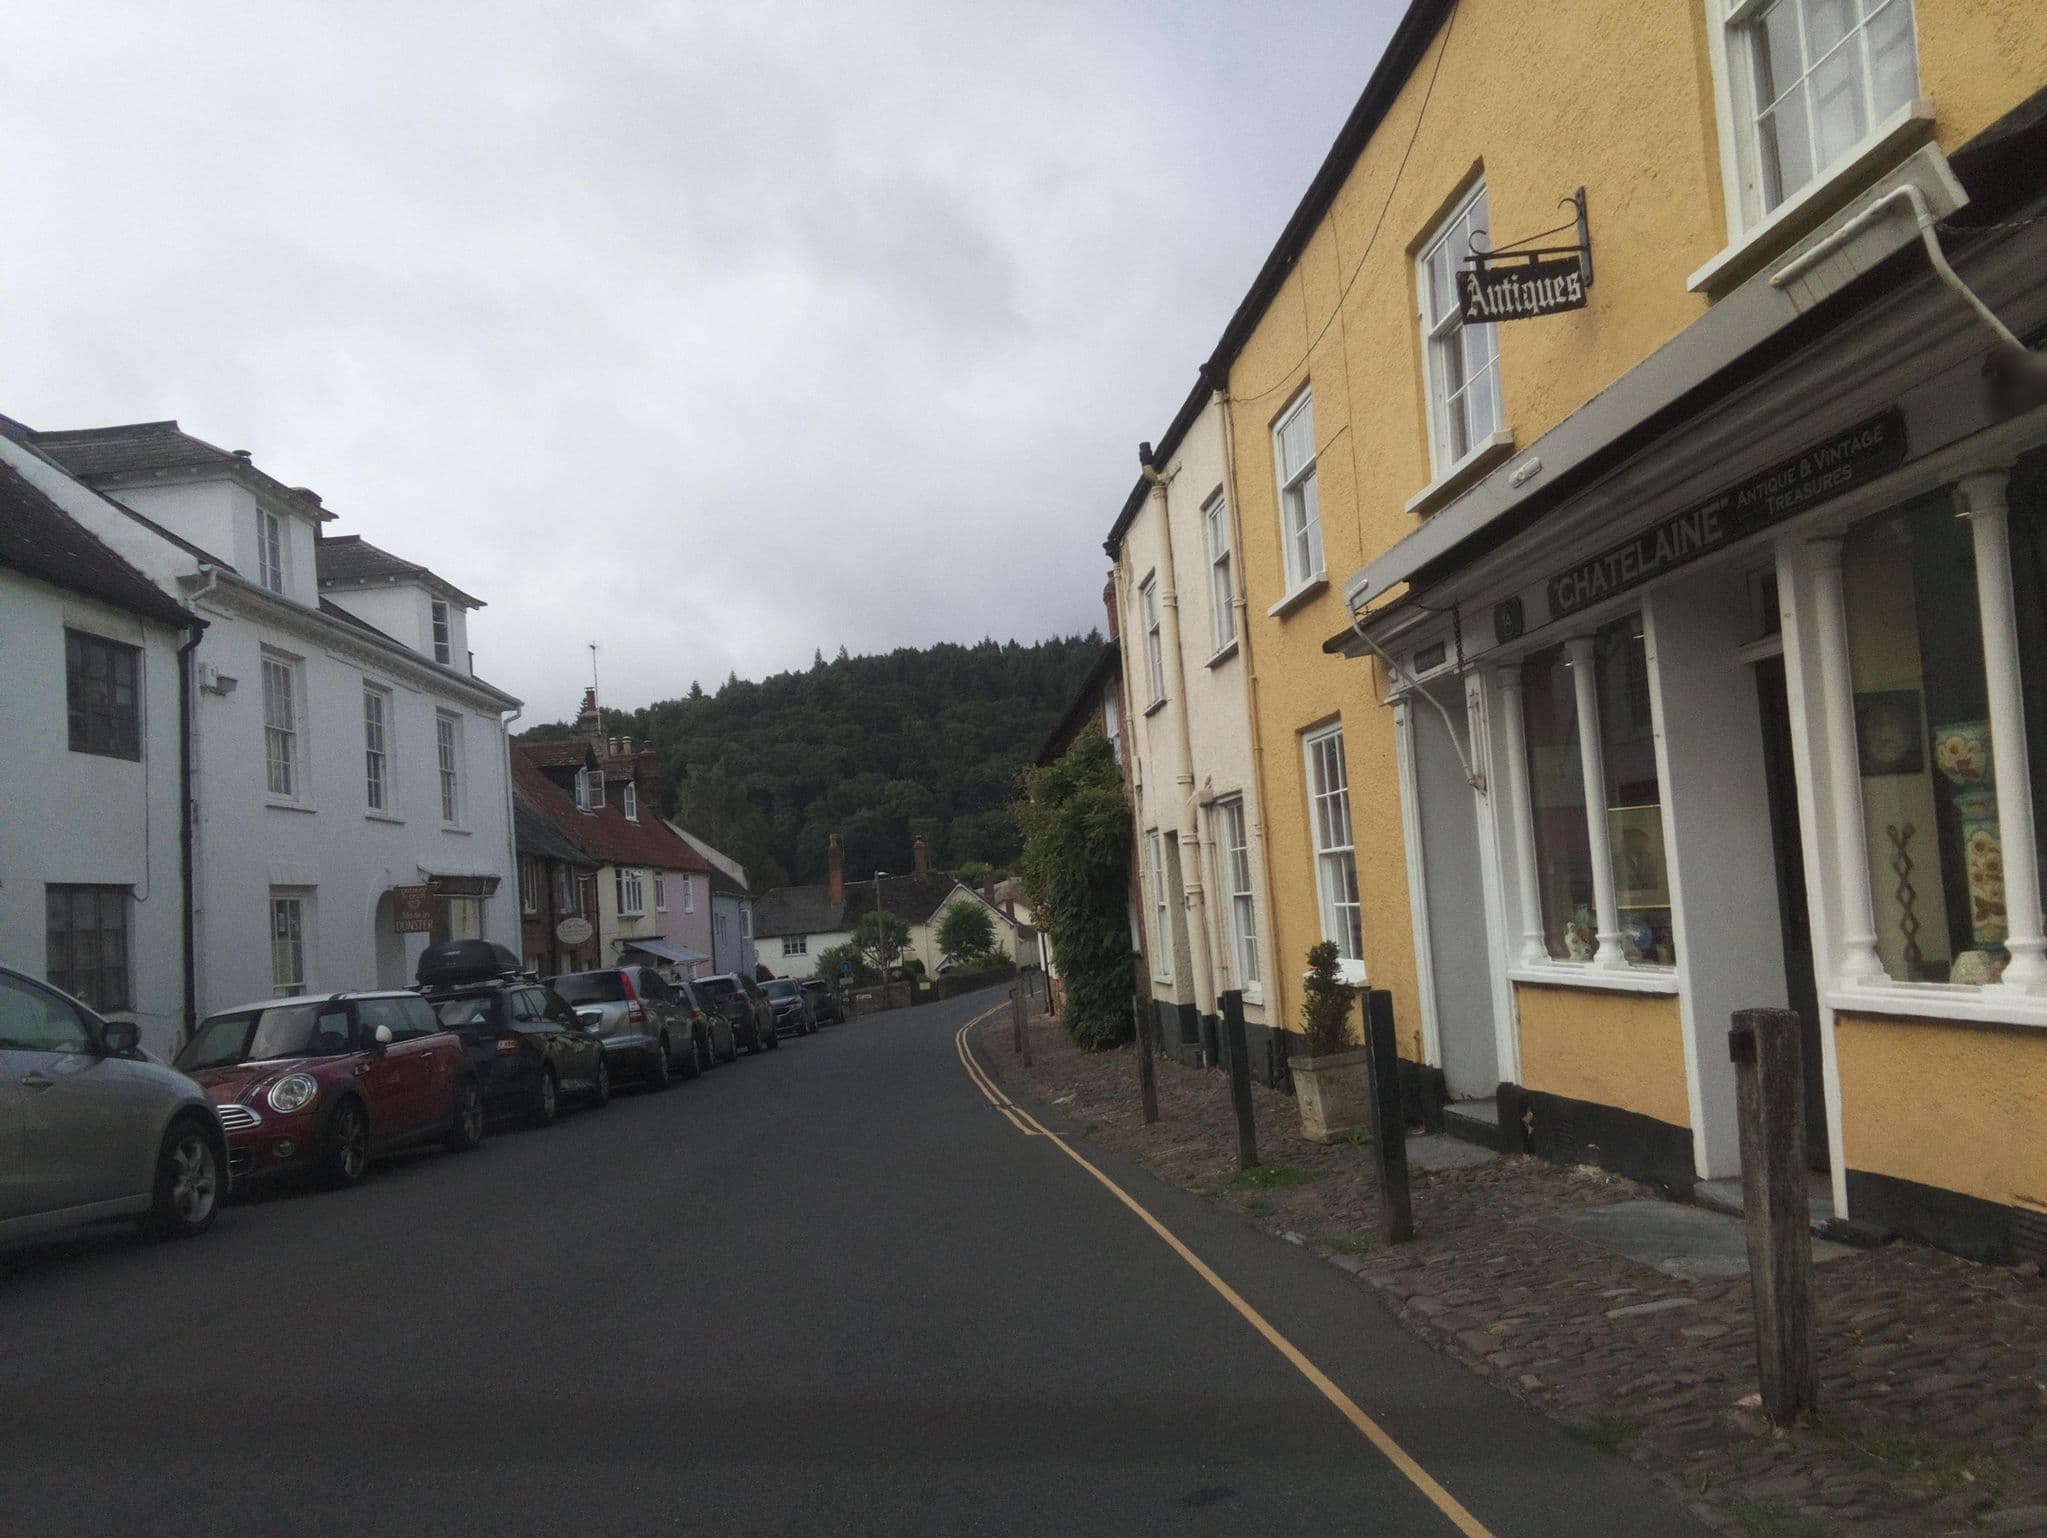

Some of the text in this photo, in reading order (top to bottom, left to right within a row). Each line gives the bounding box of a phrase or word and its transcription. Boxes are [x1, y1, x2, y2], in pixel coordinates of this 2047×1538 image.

[1466, 271, 1582, 317] Antiques
[1736, 422, 1884, 509] ANTIQUE & VINTAGE
[1766, 464, 1853, 516] TREASURES
[395, 919, 433, 932] DUNSTER
